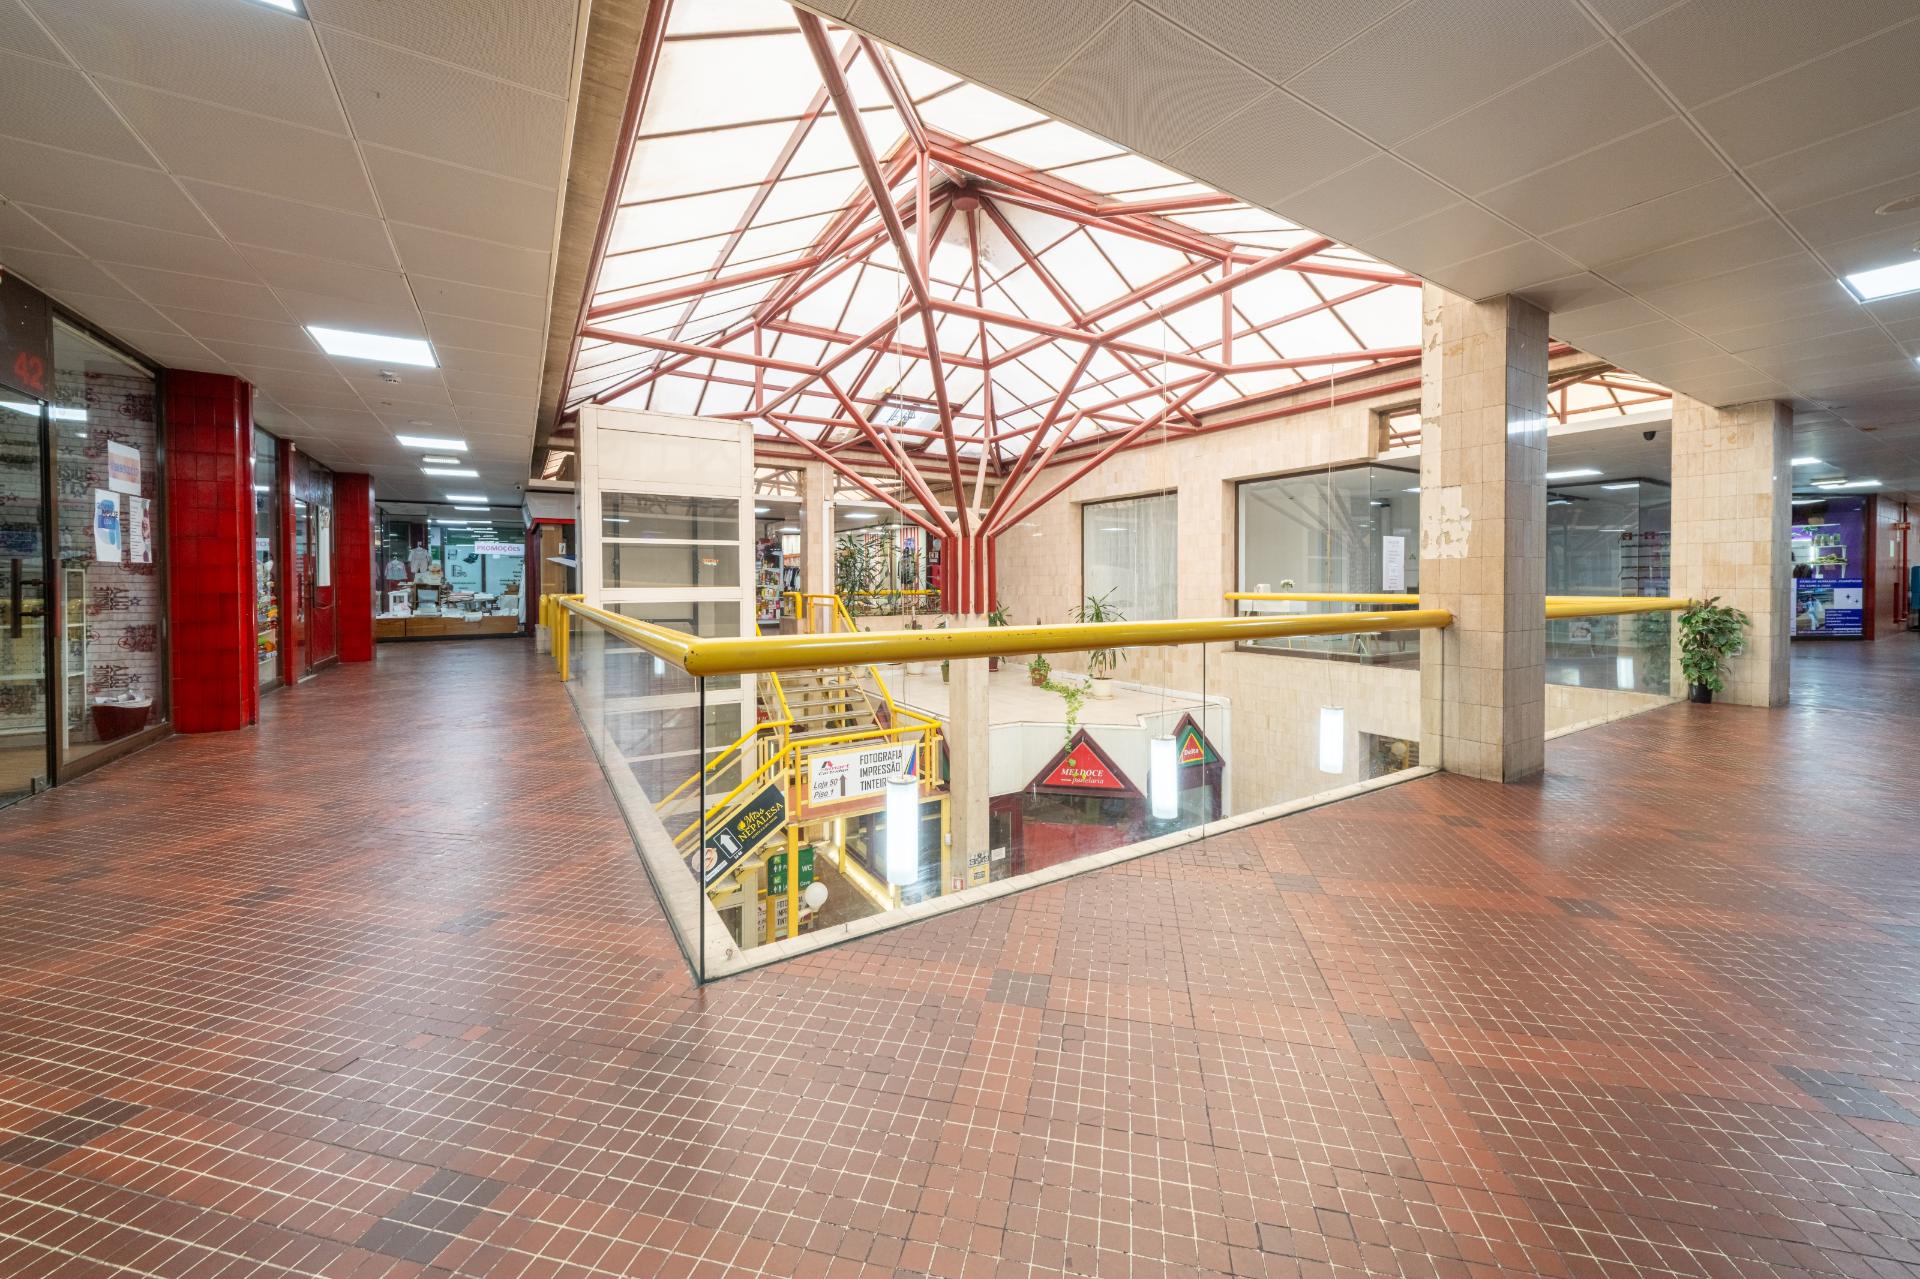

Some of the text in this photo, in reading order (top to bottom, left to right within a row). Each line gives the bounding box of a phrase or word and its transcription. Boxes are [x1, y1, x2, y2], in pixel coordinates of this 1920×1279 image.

[13, 351, 44, 390] 42
[860, 749, 902, 765] FOTOGRAFIA
[860, 762, 900, 777] IMPRESSÃO
[1061, 768, 1104, 777] MELDOCE
[814, 778, 838, 789] Loja 50
[860, 778, 887, 791] TINTEIR
[738, 802, 784, 842] NEPALESA
[801, 864, 813, 872] WC
